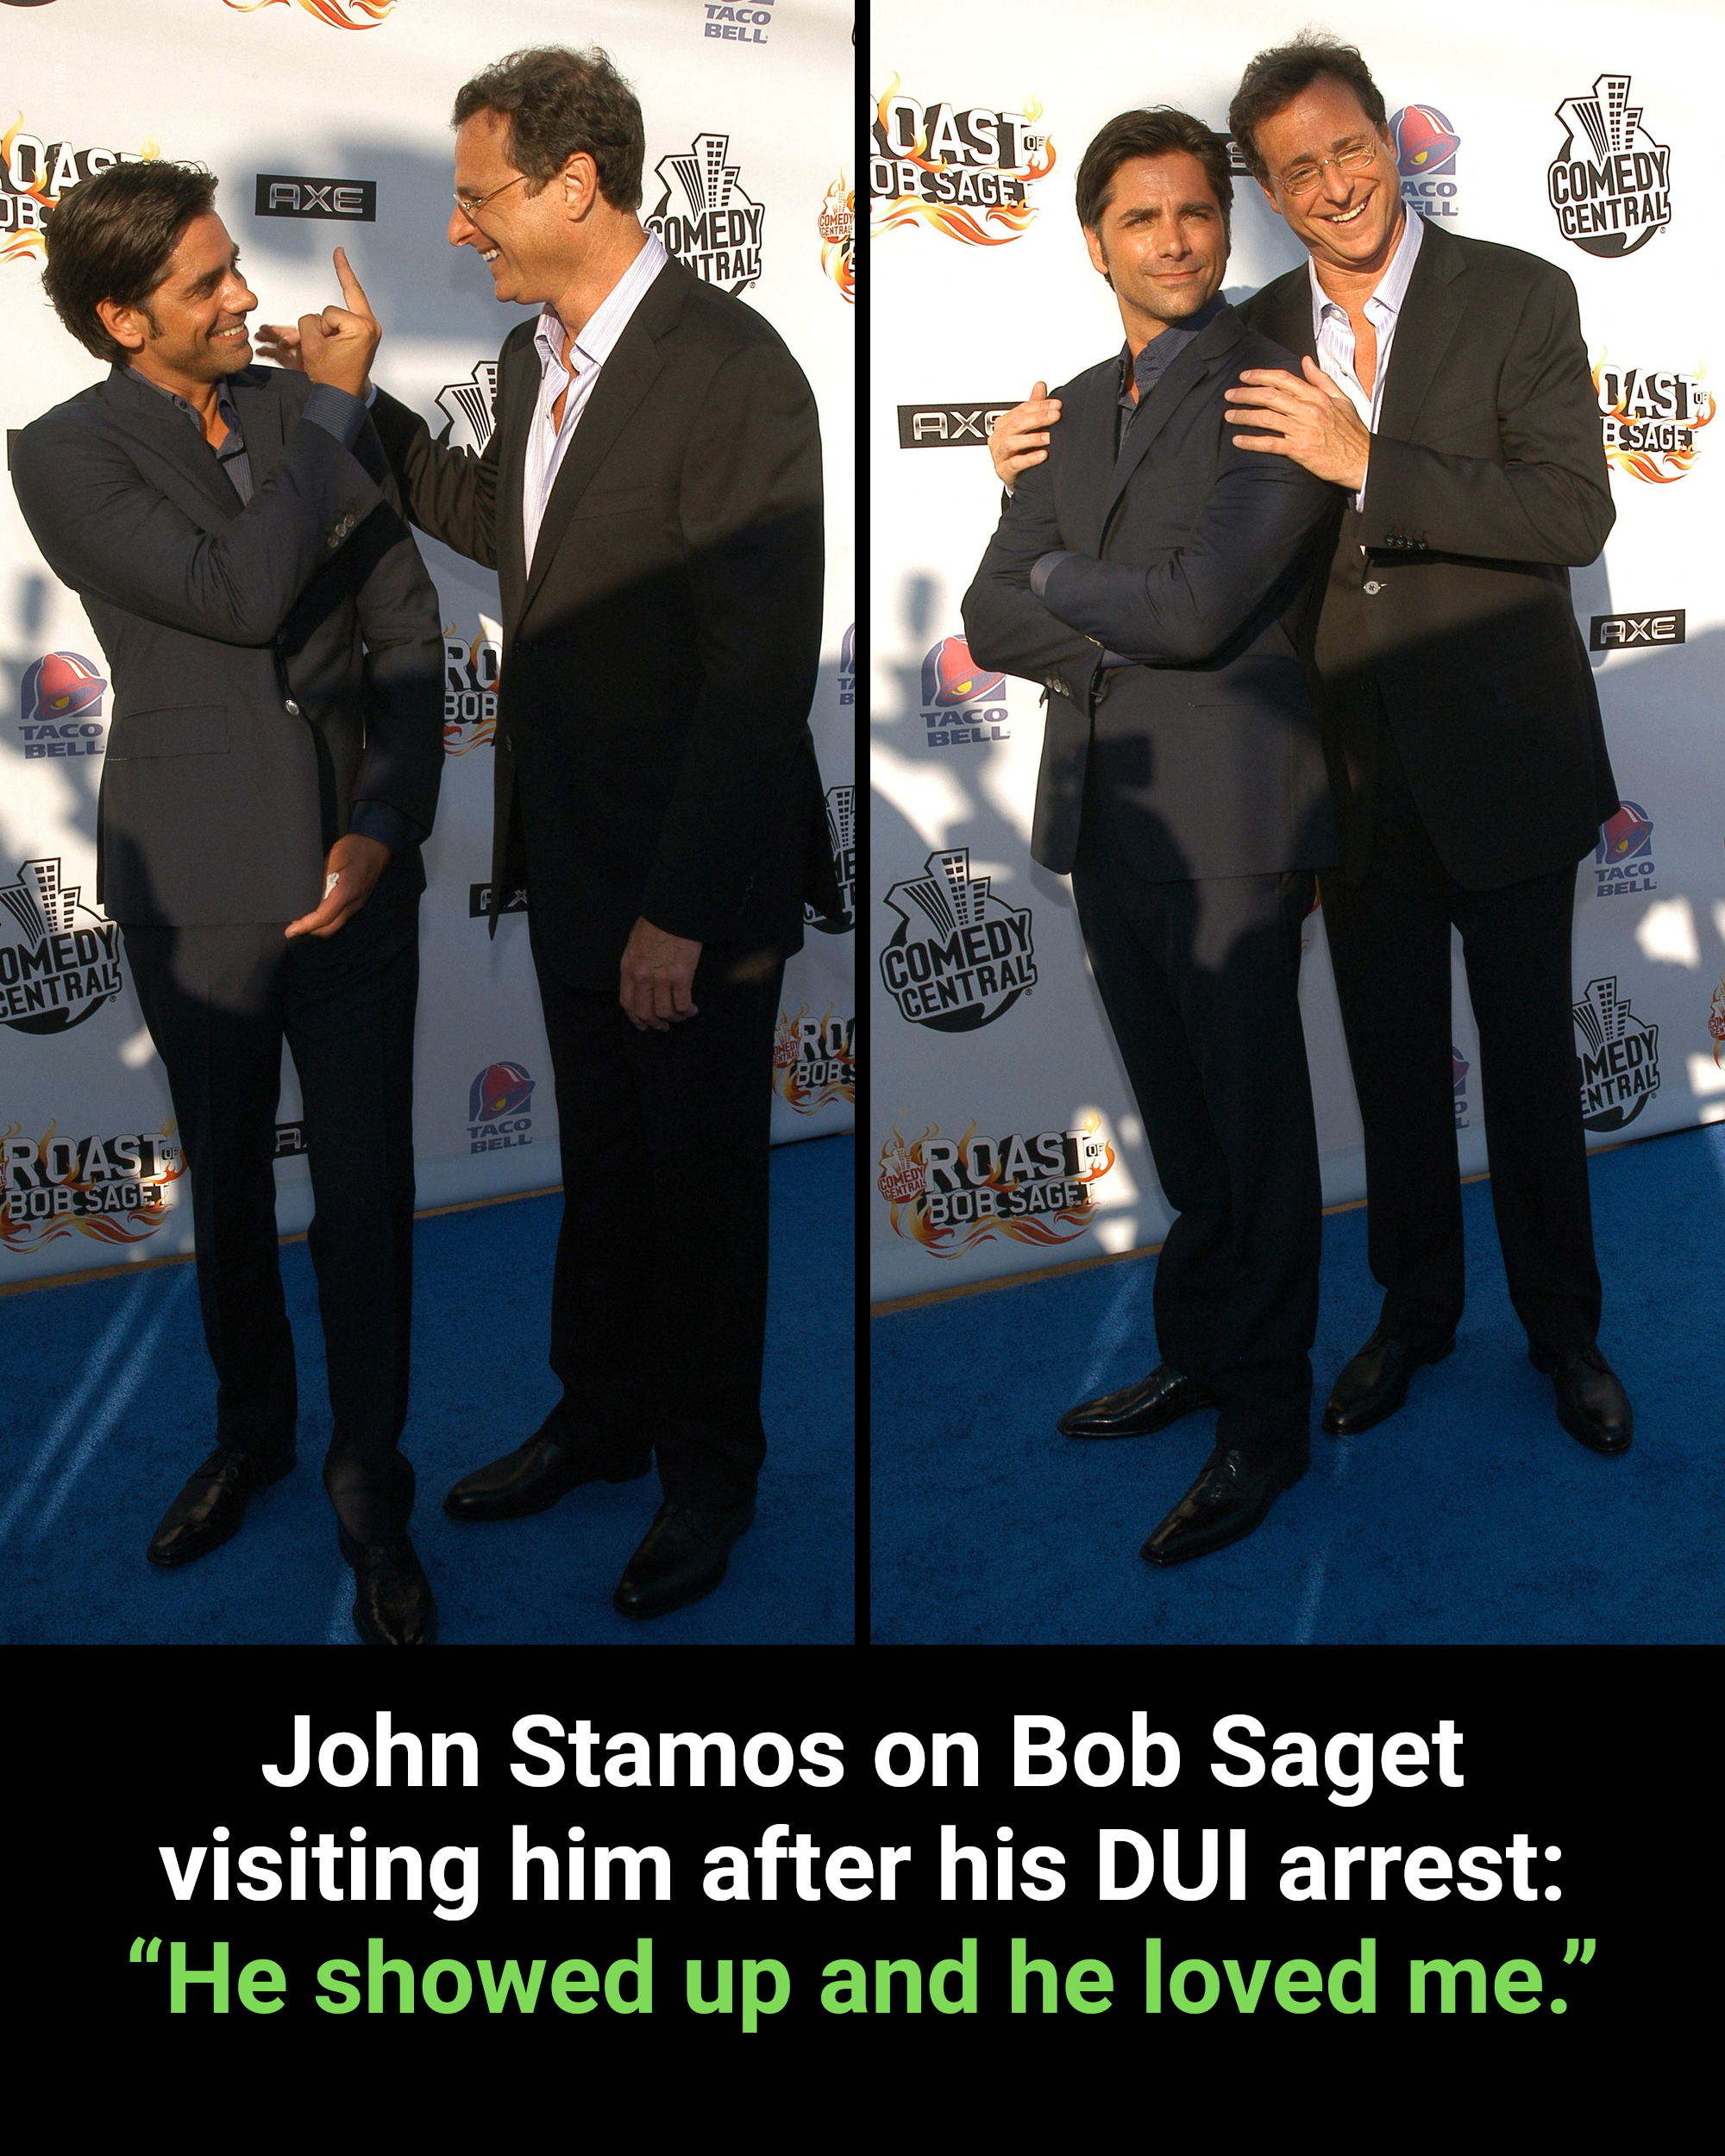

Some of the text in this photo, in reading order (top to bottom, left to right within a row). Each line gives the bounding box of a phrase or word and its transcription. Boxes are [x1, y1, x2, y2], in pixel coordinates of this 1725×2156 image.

[704, 3, 772, 26] TACO
[704, 22, 768, 44] BELL
[870, 94, 1045, 169] OAST OF
[870, 158, 1034, 208] OB SAGET
[1401, 181, 1458, 197] ACO
[1552, 151, 1666, 205] COMEDY
[269, 184, 364, 215] AXE
[1407, 200, 1459, 216] ELL
[1562, 191, 1668, 235] CENTRAL
[819, 212, 854, 227] COMEDY
[678, 248, 758, 282] NTRAL
[1597, 365, 1709, 420] OAST OF
[1628, 421, 1702, 451] SAGET
[1600, 616, 1677, 644] AXE
[444, 691, 498, 721] BOB
[919, 708, 1008, 730] TACO
[18, 724, 104, 741] TACO
[927, 725, 1011, 748] BELL
[24, 741, 105, 759] BELL
[1594, 862, 1655, 882] TACO
[1596, 880, 1657, 897] BELL
[0, 924, 114, 986] OMEDY
[885, 914, 1028, 989] COMEDY
[901, 956, 1032, 1018] CENTRAL
[775, 1040, 800, 1055] OMEDY
[1578, 1029, 1654, 1087] MEDY
[796, 1061, 842, 1087] BOB
[1580, 1064, 1657, 1115] ENTRAL
[467, 1118, 532, 1139] TACO
[470, 1133, 533, 1155] BELL
[3, 1133, 168, 1190] ROAST
[162, 1147, 179, 1161] OF
[923, 1130, 1106, 1194] ROAST OF
[880, 1165, 925, 1192] COMEDY
[884, 1178, 927, 1200] CENTRAL
[8, 1181, 170, 1220] BOB SAGET
[927, 1181, 1095, 1224] BOB SAGET
